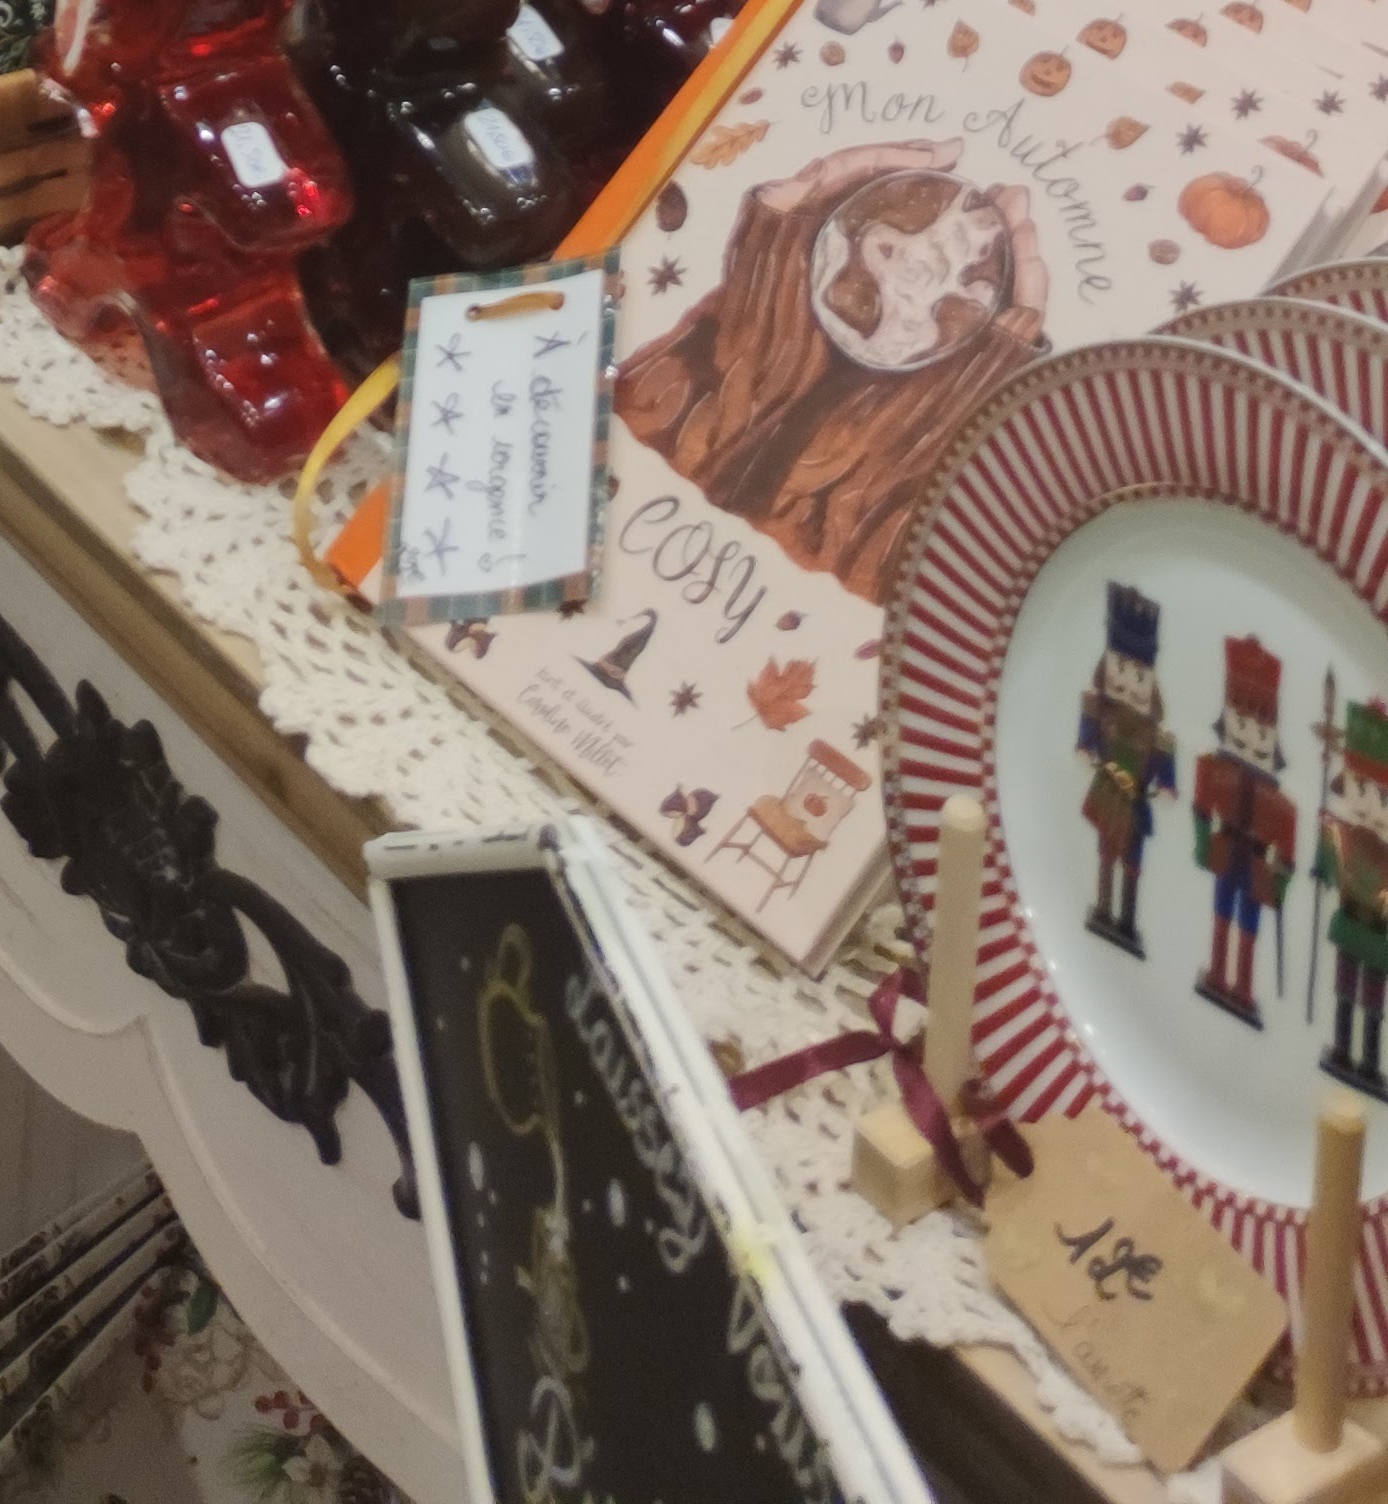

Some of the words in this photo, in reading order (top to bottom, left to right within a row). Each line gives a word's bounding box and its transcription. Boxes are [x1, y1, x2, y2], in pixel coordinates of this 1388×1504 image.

[801, 80, 947, 136] Mon
[963, 97, 1113, 306] Automne
[619, 493, 768, 645] COSY
[1054, 1215, 1164, 1301] 12€
